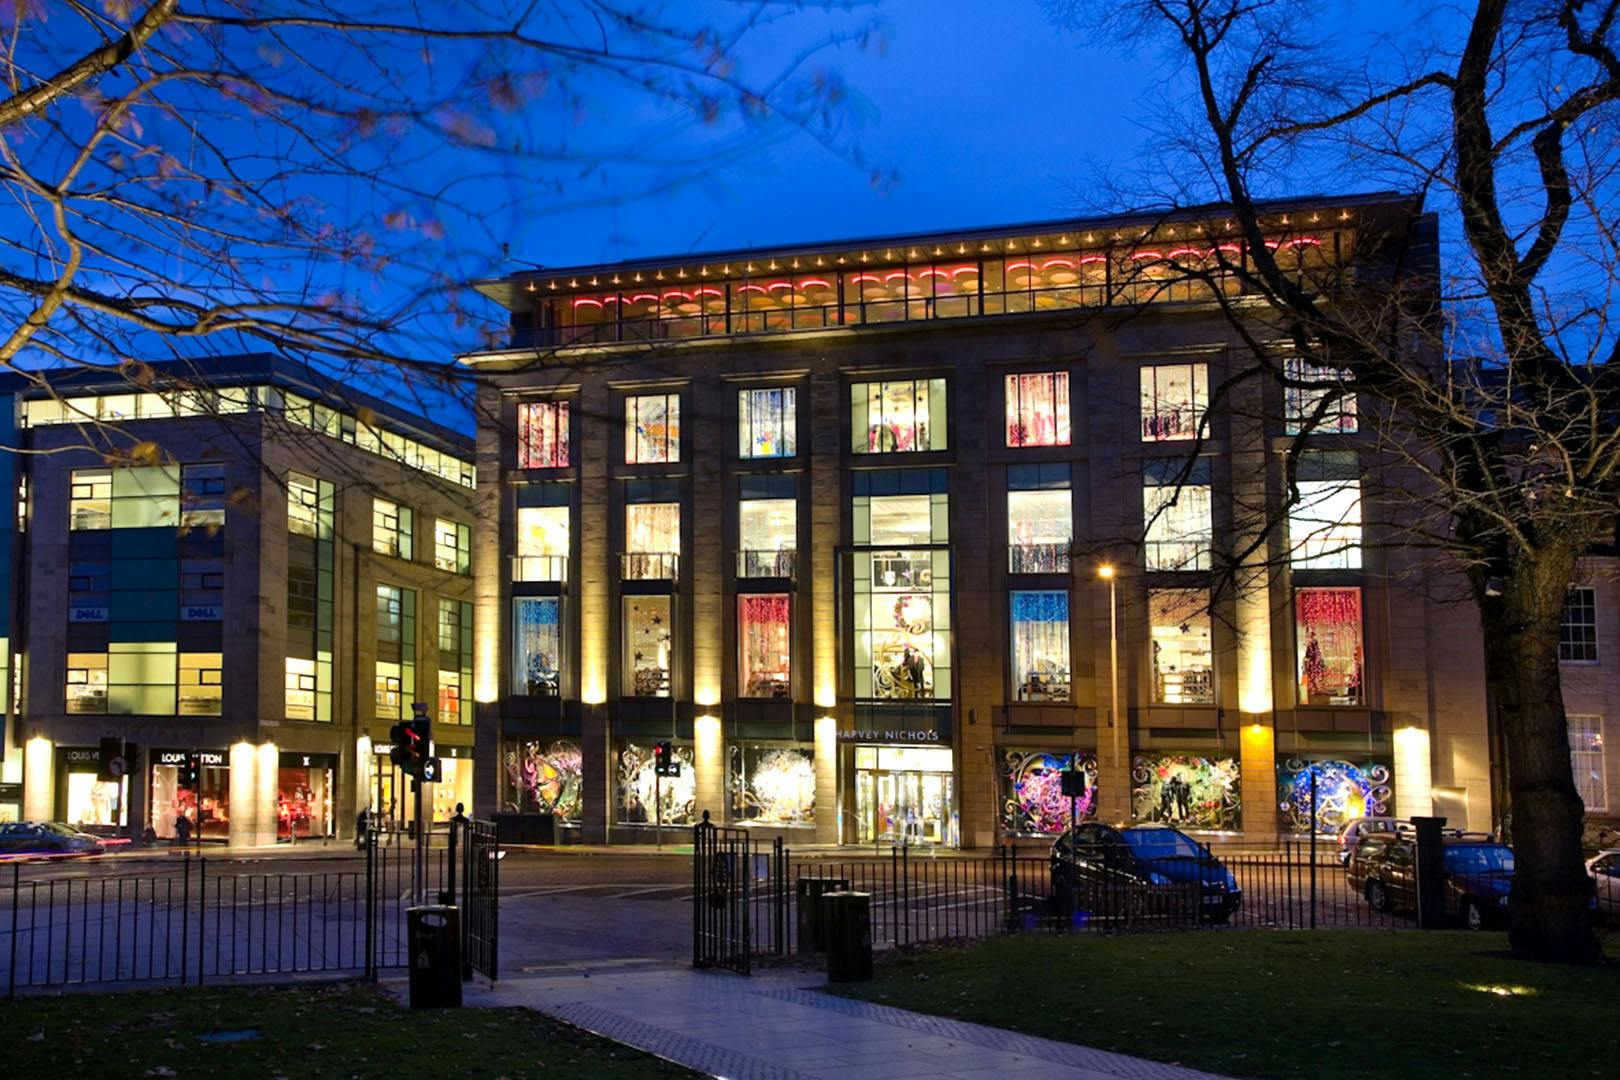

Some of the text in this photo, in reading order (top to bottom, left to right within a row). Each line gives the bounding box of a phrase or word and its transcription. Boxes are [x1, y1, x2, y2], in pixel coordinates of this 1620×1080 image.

[76, 610, 103, 619] DELL
[188, 608, 216, 618] DELL
[836, 730, 939, 741] HARVEY NICHOLS
